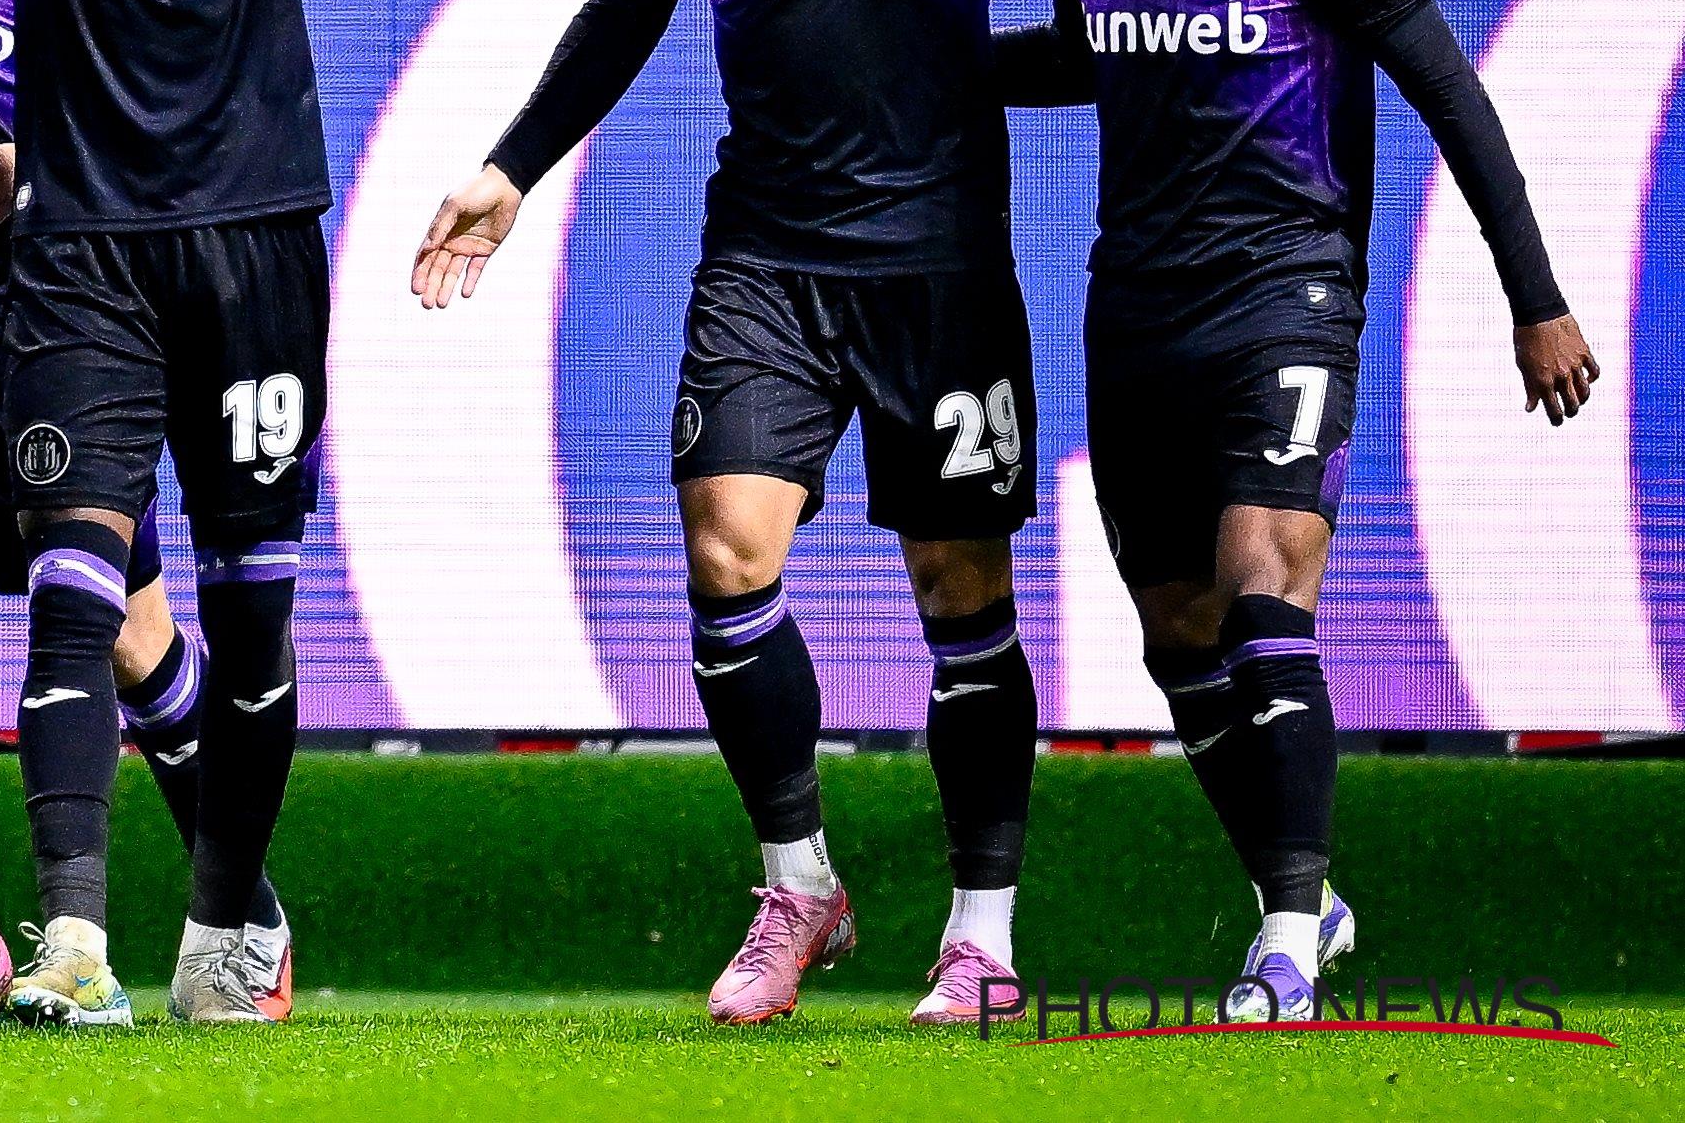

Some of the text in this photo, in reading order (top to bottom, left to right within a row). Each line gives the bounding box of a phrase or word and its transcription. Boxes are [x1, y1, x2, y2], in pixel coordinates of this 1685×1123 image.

[1085, 0, 1268, 55] unweb
[222, 372, 304, 463] 19
[933, 378, 1021, 479] 29
[1277, 365, 1329, 447] 7
